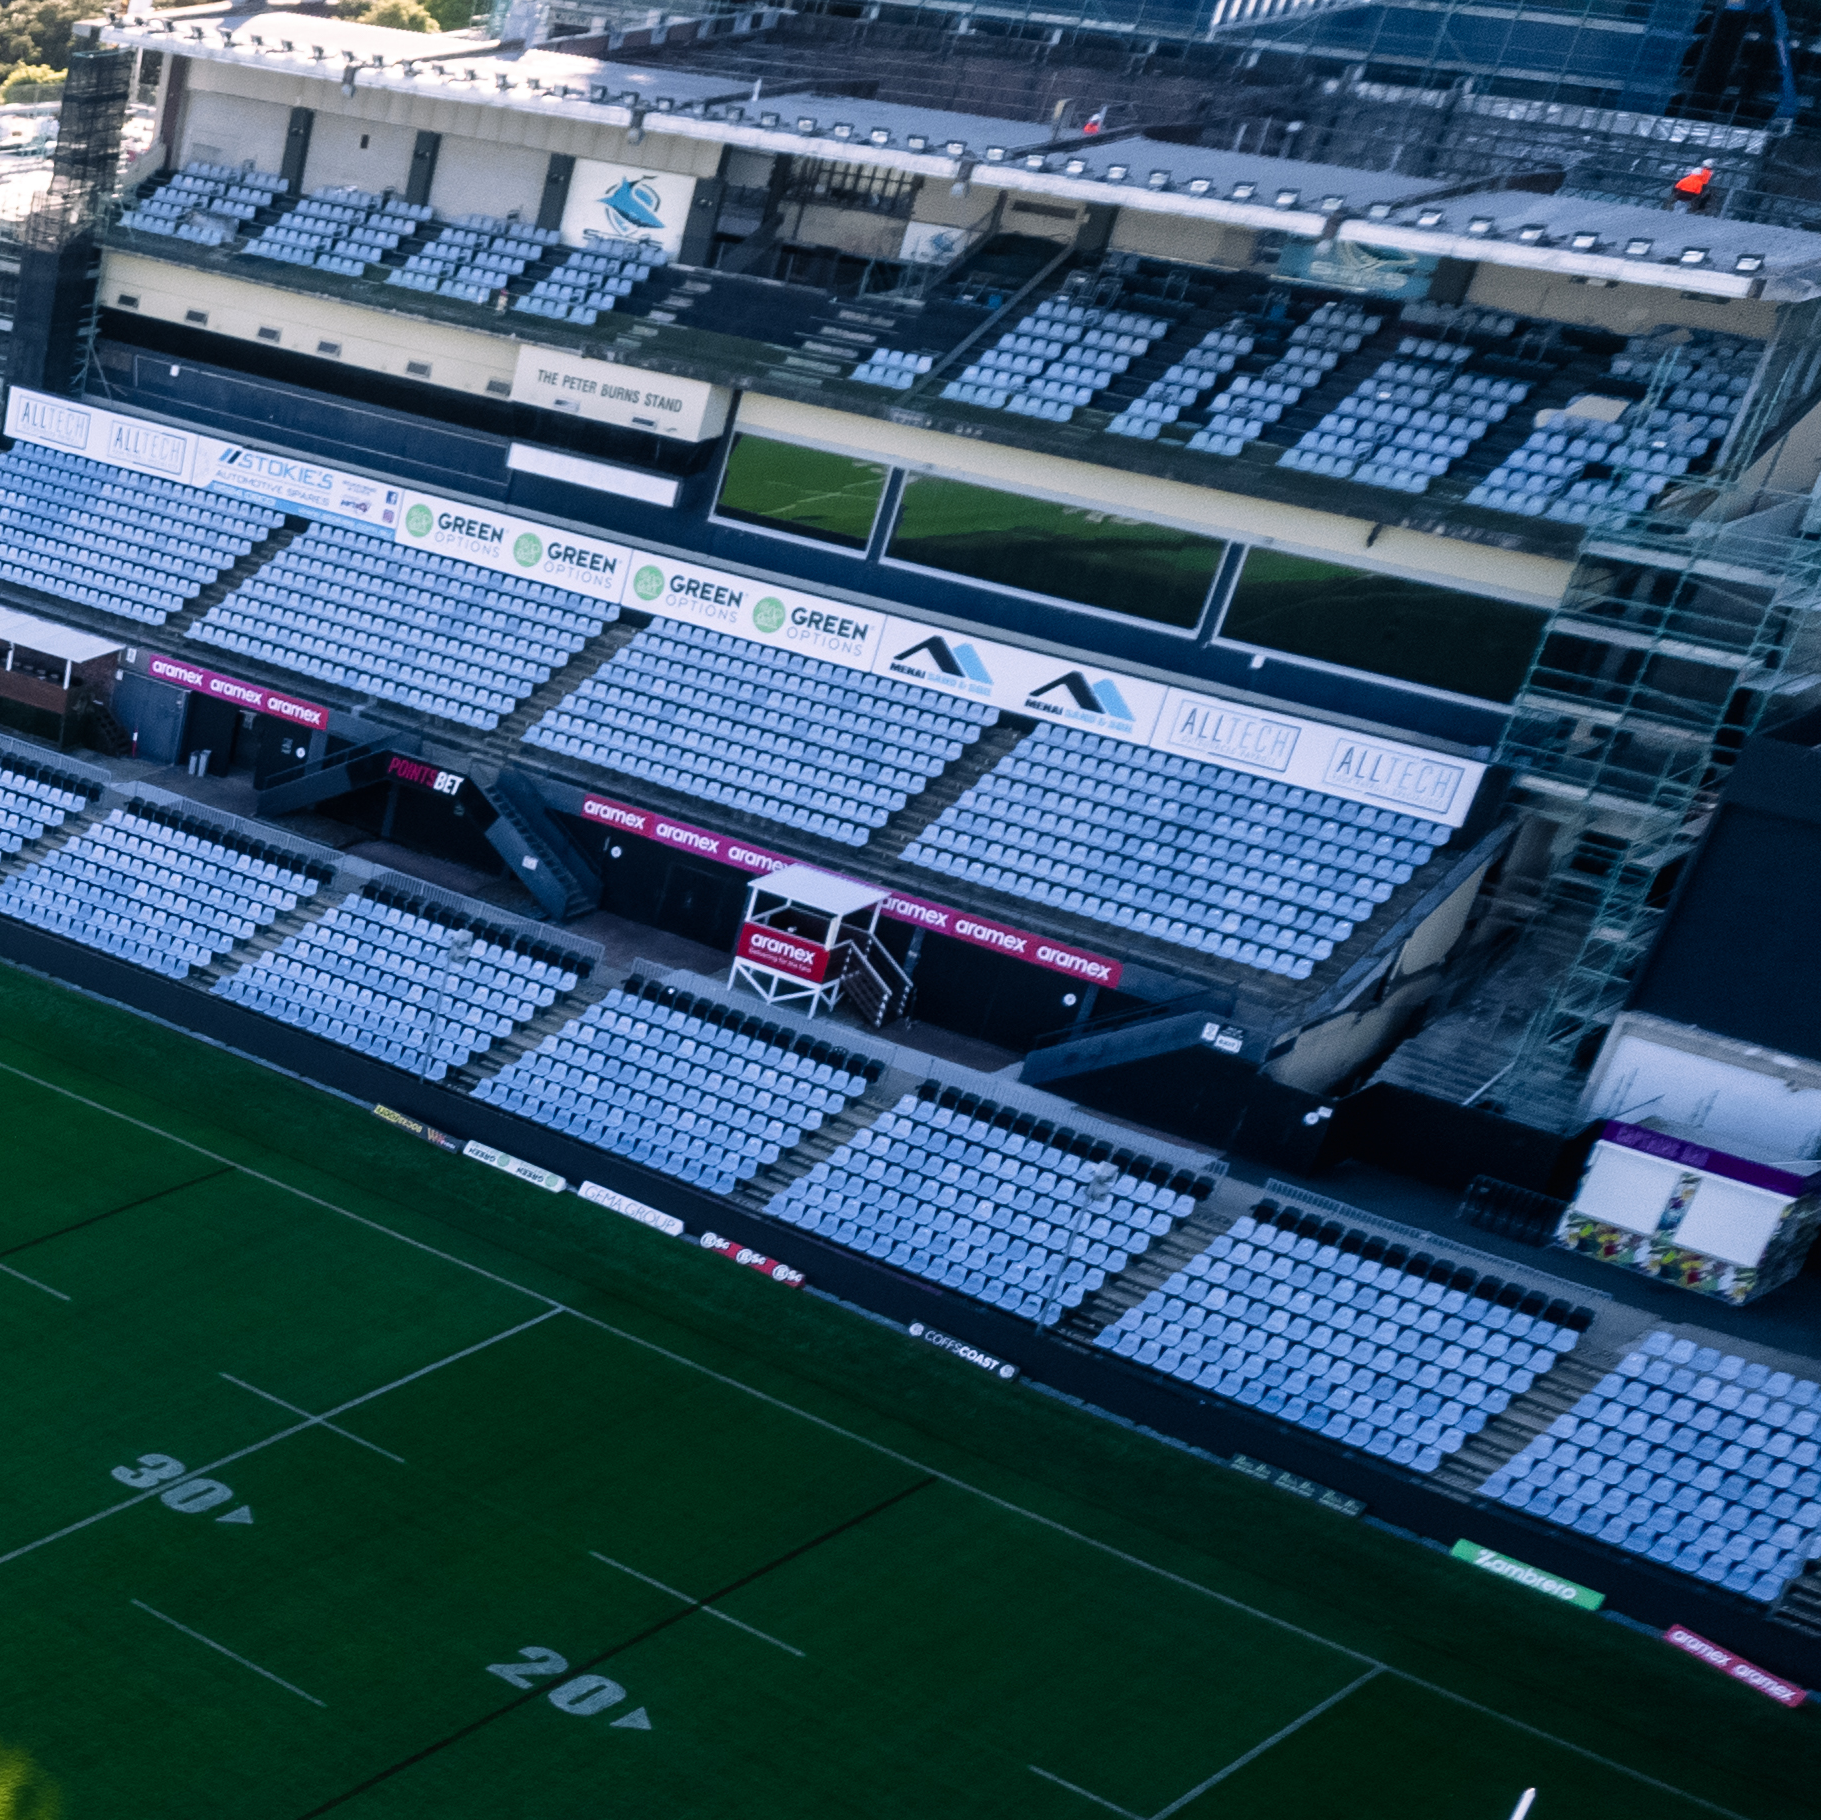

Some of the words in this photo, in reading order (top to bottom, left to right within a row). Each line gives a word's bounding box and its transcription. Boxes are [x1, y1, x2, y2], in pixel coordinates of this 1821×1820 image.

[538, 368, 559, 386] THE
[562, 375, 598, 394] PETER
[600, 383, 640, 404] BURNS
[644, 392, 683, 413] STAND
[21, 401, 87, 437] ALLTECH
[114, 426, 183, 461] ALLTECH
[238, 453, 334, 490] STOKIE'S
[434, 531, 500, 559] OPTIONS
[438, 512, 505, 544] GREEN
[543, 560, 613, 590] OPTIONS
[547, 541, 618, 575] GREEN
[665, 593, 738, 624] OPTIONS
[669, 574, 744, 609] GREEN
[786, 625, 862, 657] OPTIONS
[791, 606, 869, 642] GREEN
[152, 660, 204, 687] aramex
[210, 678, 262, 706] aramex
[267, 695, 322, 725] aramex
[1179, 706, 1289, 751] ALLTECH
[388, 756, 465, 796] POINTSBET
[1335, 745, 1453, 797] ALLTECH
[584, 799, 646, 830] aramex
[656, 822, 720, 854] aramex
[751, 933, 816, 965] aramex
[955, 918, 1028, 953] aramex
[1036, 945, 1112, 980] aramex
[584, 1184, 624, 1212] GEMA
[624, 1201, 676, 1231] GROUP
[109, 1453, 234, 1514] 30
[1472, 1548, 1577, 1601] Zambrero
[485, 1646, 627, 1716] 20
[1671, 1630, 1732, 1667] aramex
[1733, 1664, 1797, 1701] aramex
